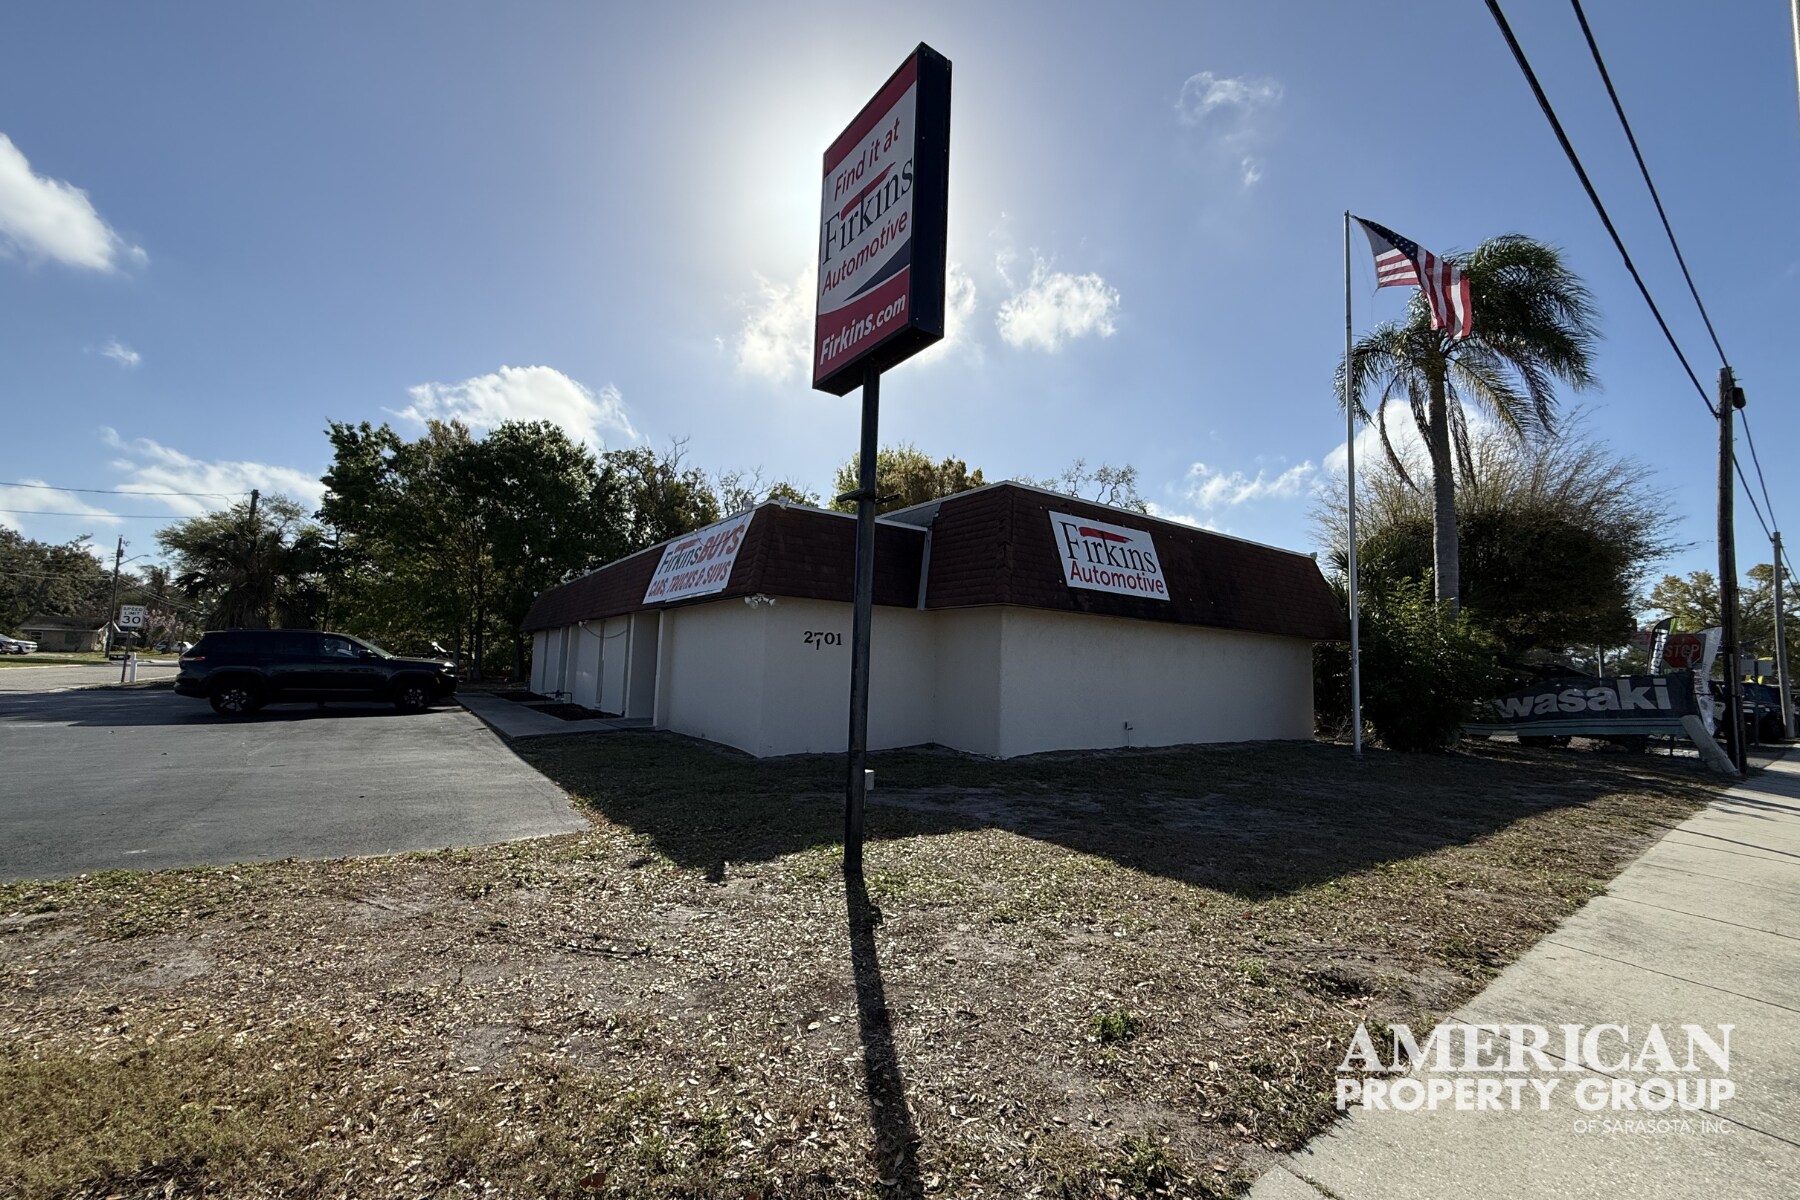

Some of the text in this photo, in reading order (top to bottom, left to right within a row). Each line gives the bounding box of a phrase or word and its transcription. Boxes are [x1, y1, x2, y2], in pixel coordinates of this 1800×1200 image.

[834, 116, 900, 202] Find it at
[822, 157, 913, 265] Firkins
[822, 211, 908, 296] Automotive
[820, 294, 906, 365] Firkins.com
[1058, 521, 1157, 574] Firkins
[667, 569, 699, 593] TRUCKS
[1070, 560, 1165, 594] Automotive
[121, 616, 141, 624] 30
[804, 630, 842, 650] 2701
[1665, 644, 1700, 658] STOP
